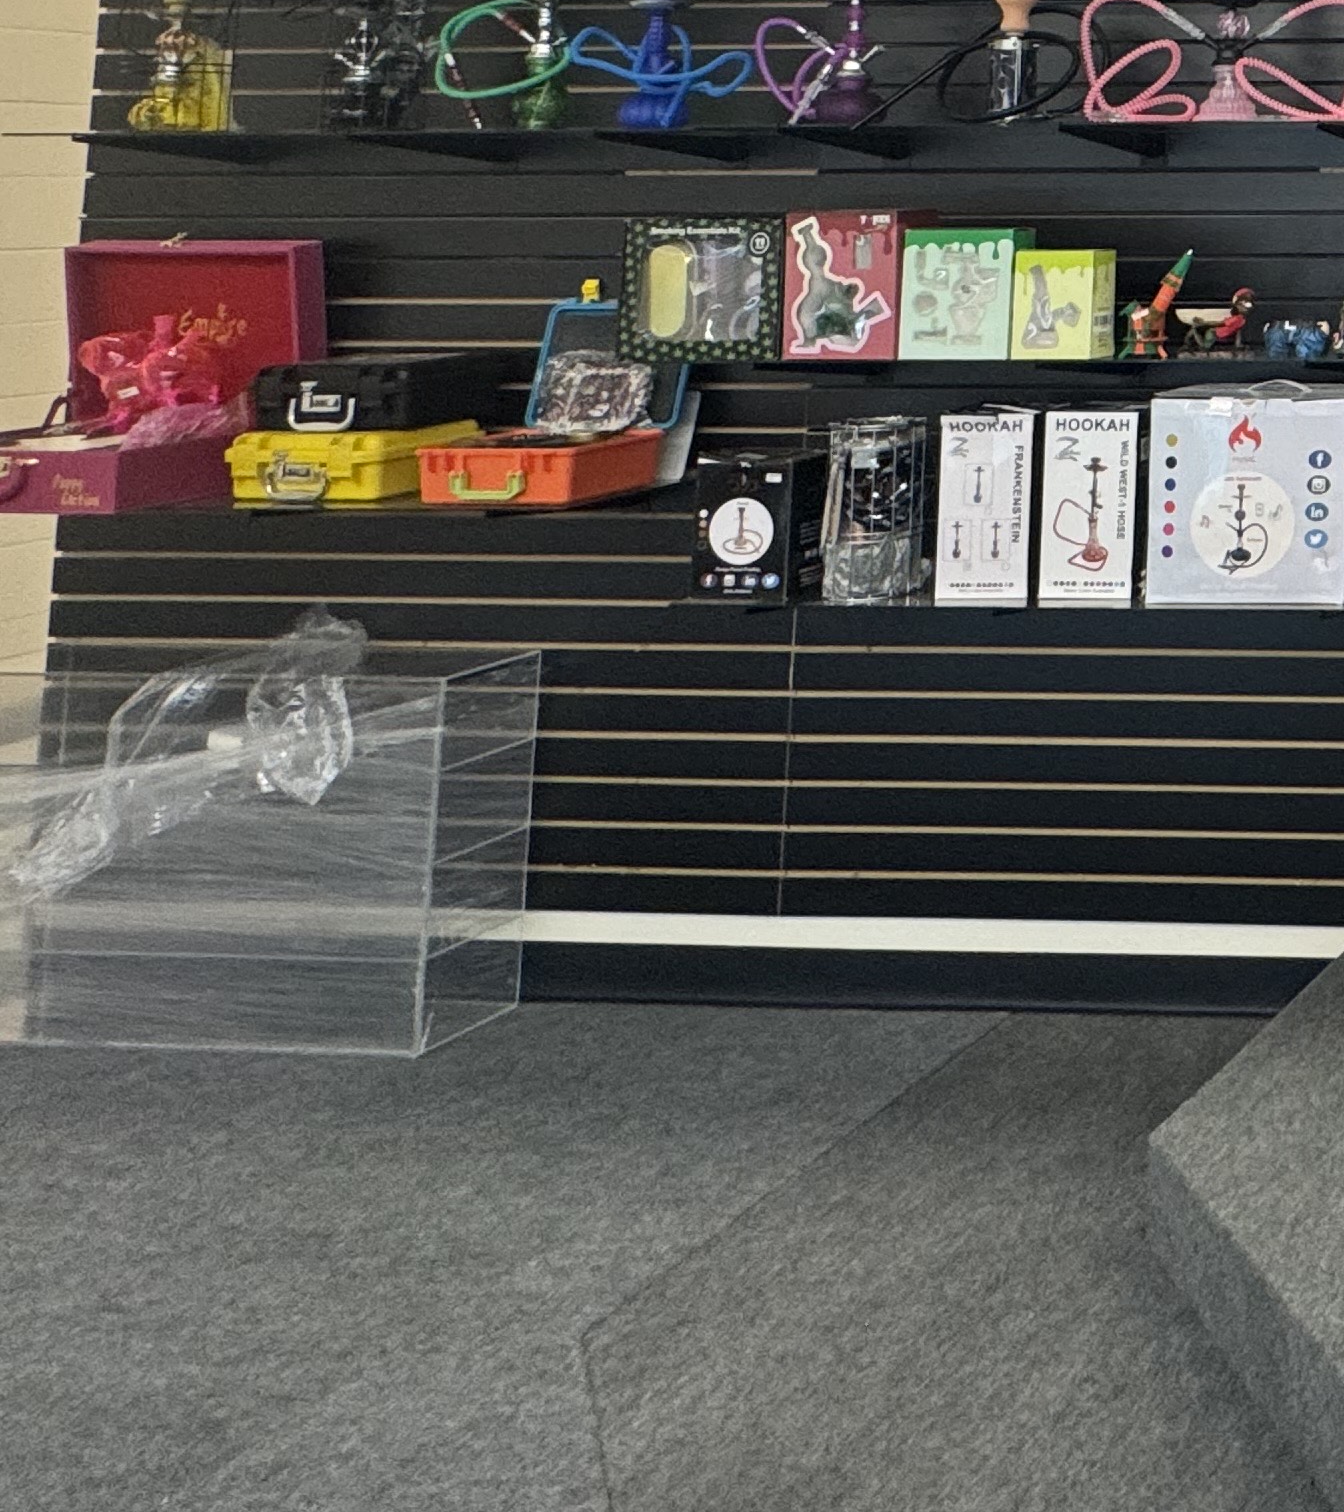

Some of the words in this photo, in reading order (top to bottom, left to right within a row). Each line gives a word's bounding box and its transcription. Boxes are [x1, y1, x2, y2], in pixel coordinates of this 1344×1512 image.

[949, 419, 1023, 433] HOOKAH
[1055, 418, 1131, 432] HOOKAH
[1011, 445, 1024, 544] FRANKENSTEIN
